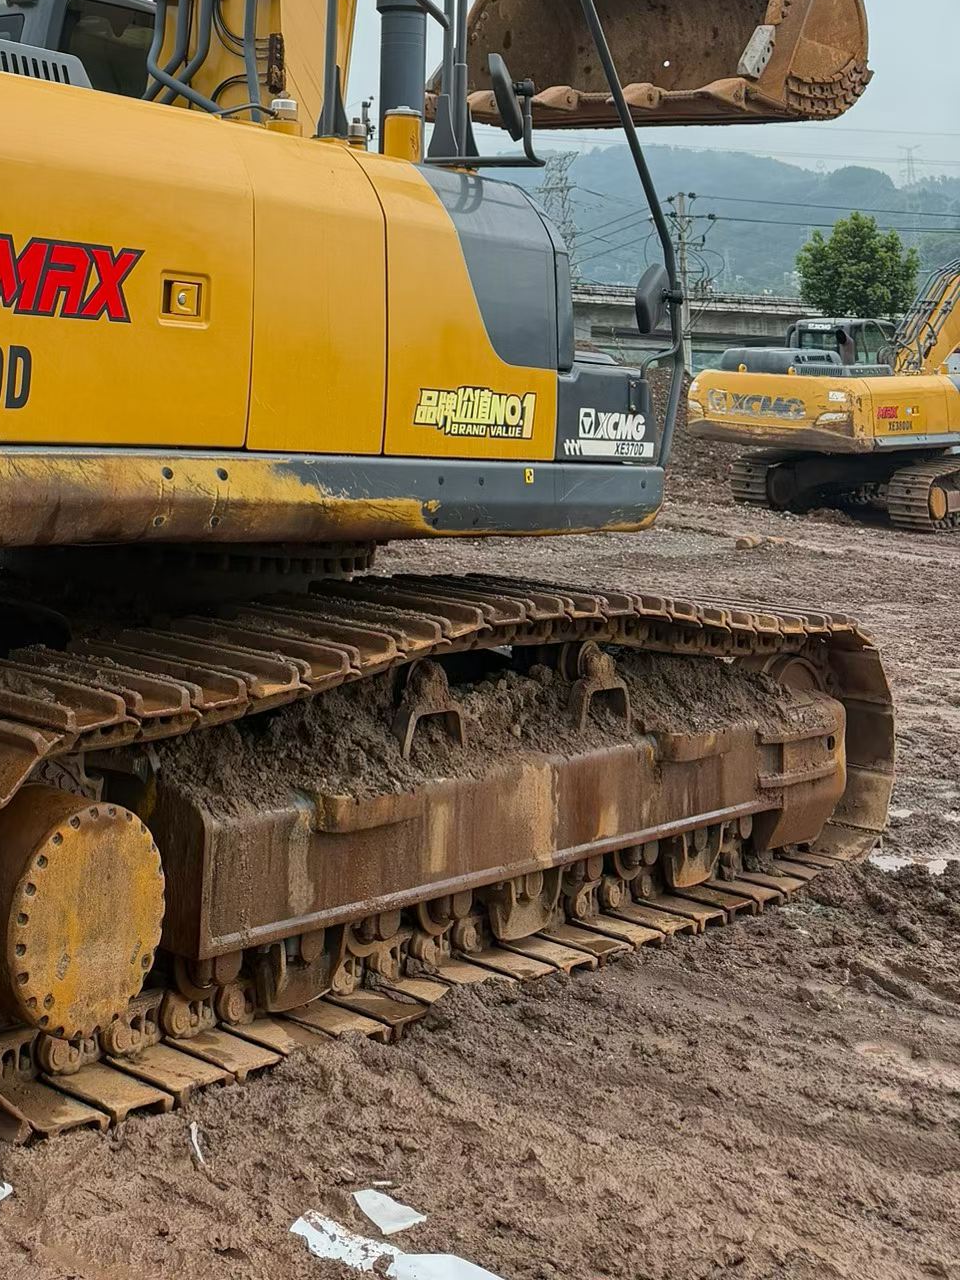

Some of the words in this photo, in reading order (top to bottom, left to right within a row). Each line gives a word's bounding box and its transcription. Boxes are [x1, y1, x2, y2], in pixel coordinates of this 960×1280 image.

[451, 423, 487, 436] BRAND
[490, 425, 522, 437] VALUE
[593, 412, 646, 441] XCMG
[614, 442, 645, 456] XE370D
